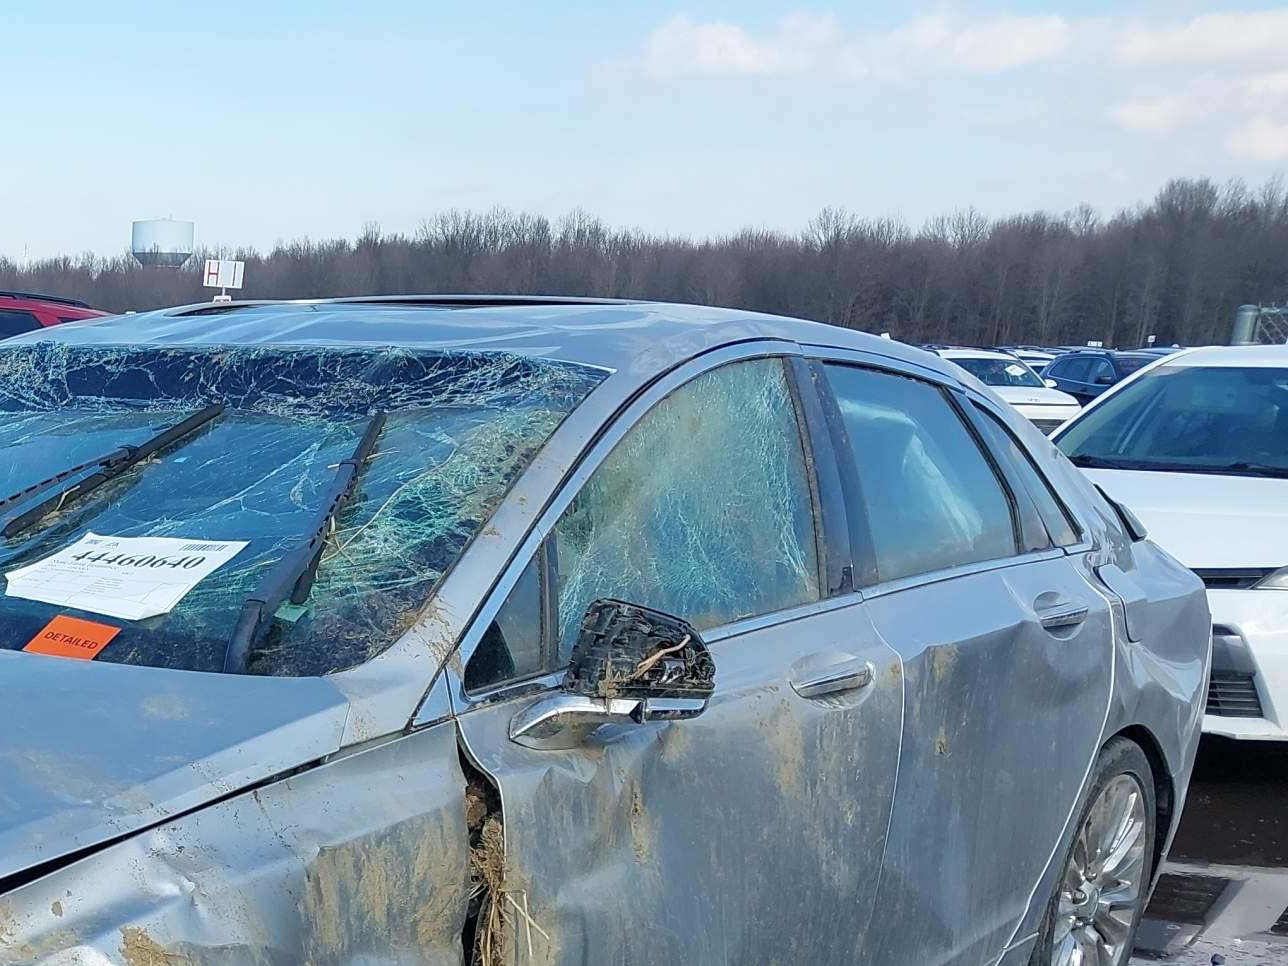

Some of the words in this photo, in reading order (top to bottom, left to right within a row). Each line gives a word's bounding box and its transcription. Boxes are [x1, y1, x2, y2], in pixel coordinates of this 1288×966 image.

[207, 262, 220, 286] H
[72, 550, 206, 570] 44460640
[44, 631, 98, 649] DETAILED
